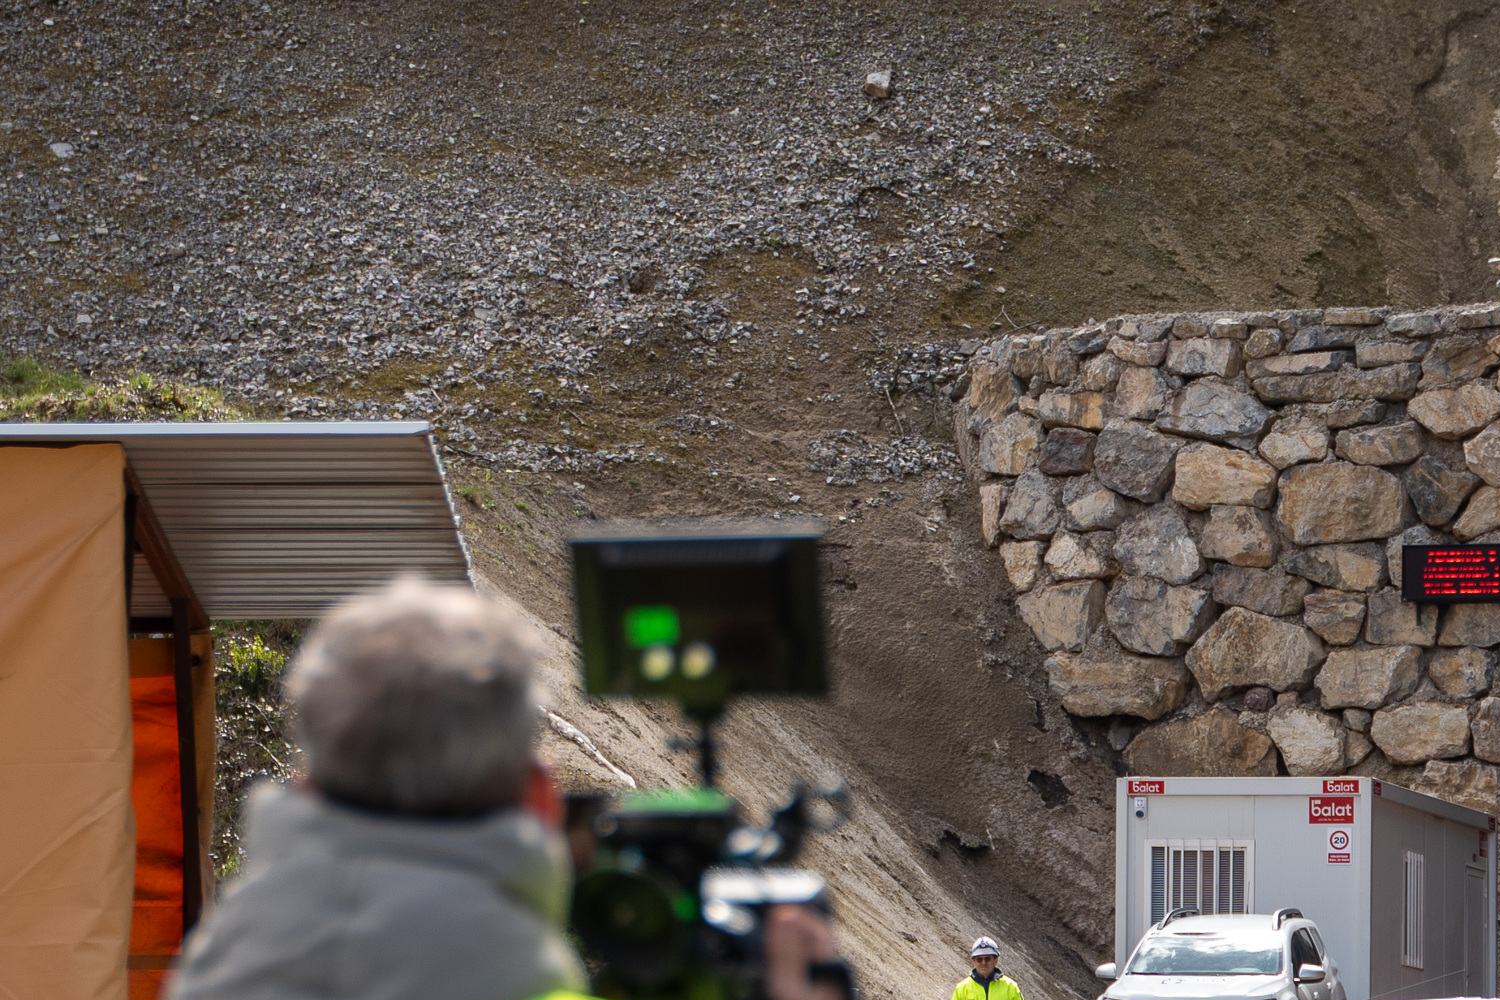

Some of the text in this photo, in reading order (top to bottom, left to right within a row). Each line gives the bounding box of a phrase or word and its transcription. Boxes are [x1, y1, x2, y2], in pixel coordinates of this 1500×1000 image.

[1132, 781, 1160, 792] balat
[1327, 781, 1355, 792] balat
[1311, 800, 1352, 817] balat
[1333, 836, 1346, 844] 20
